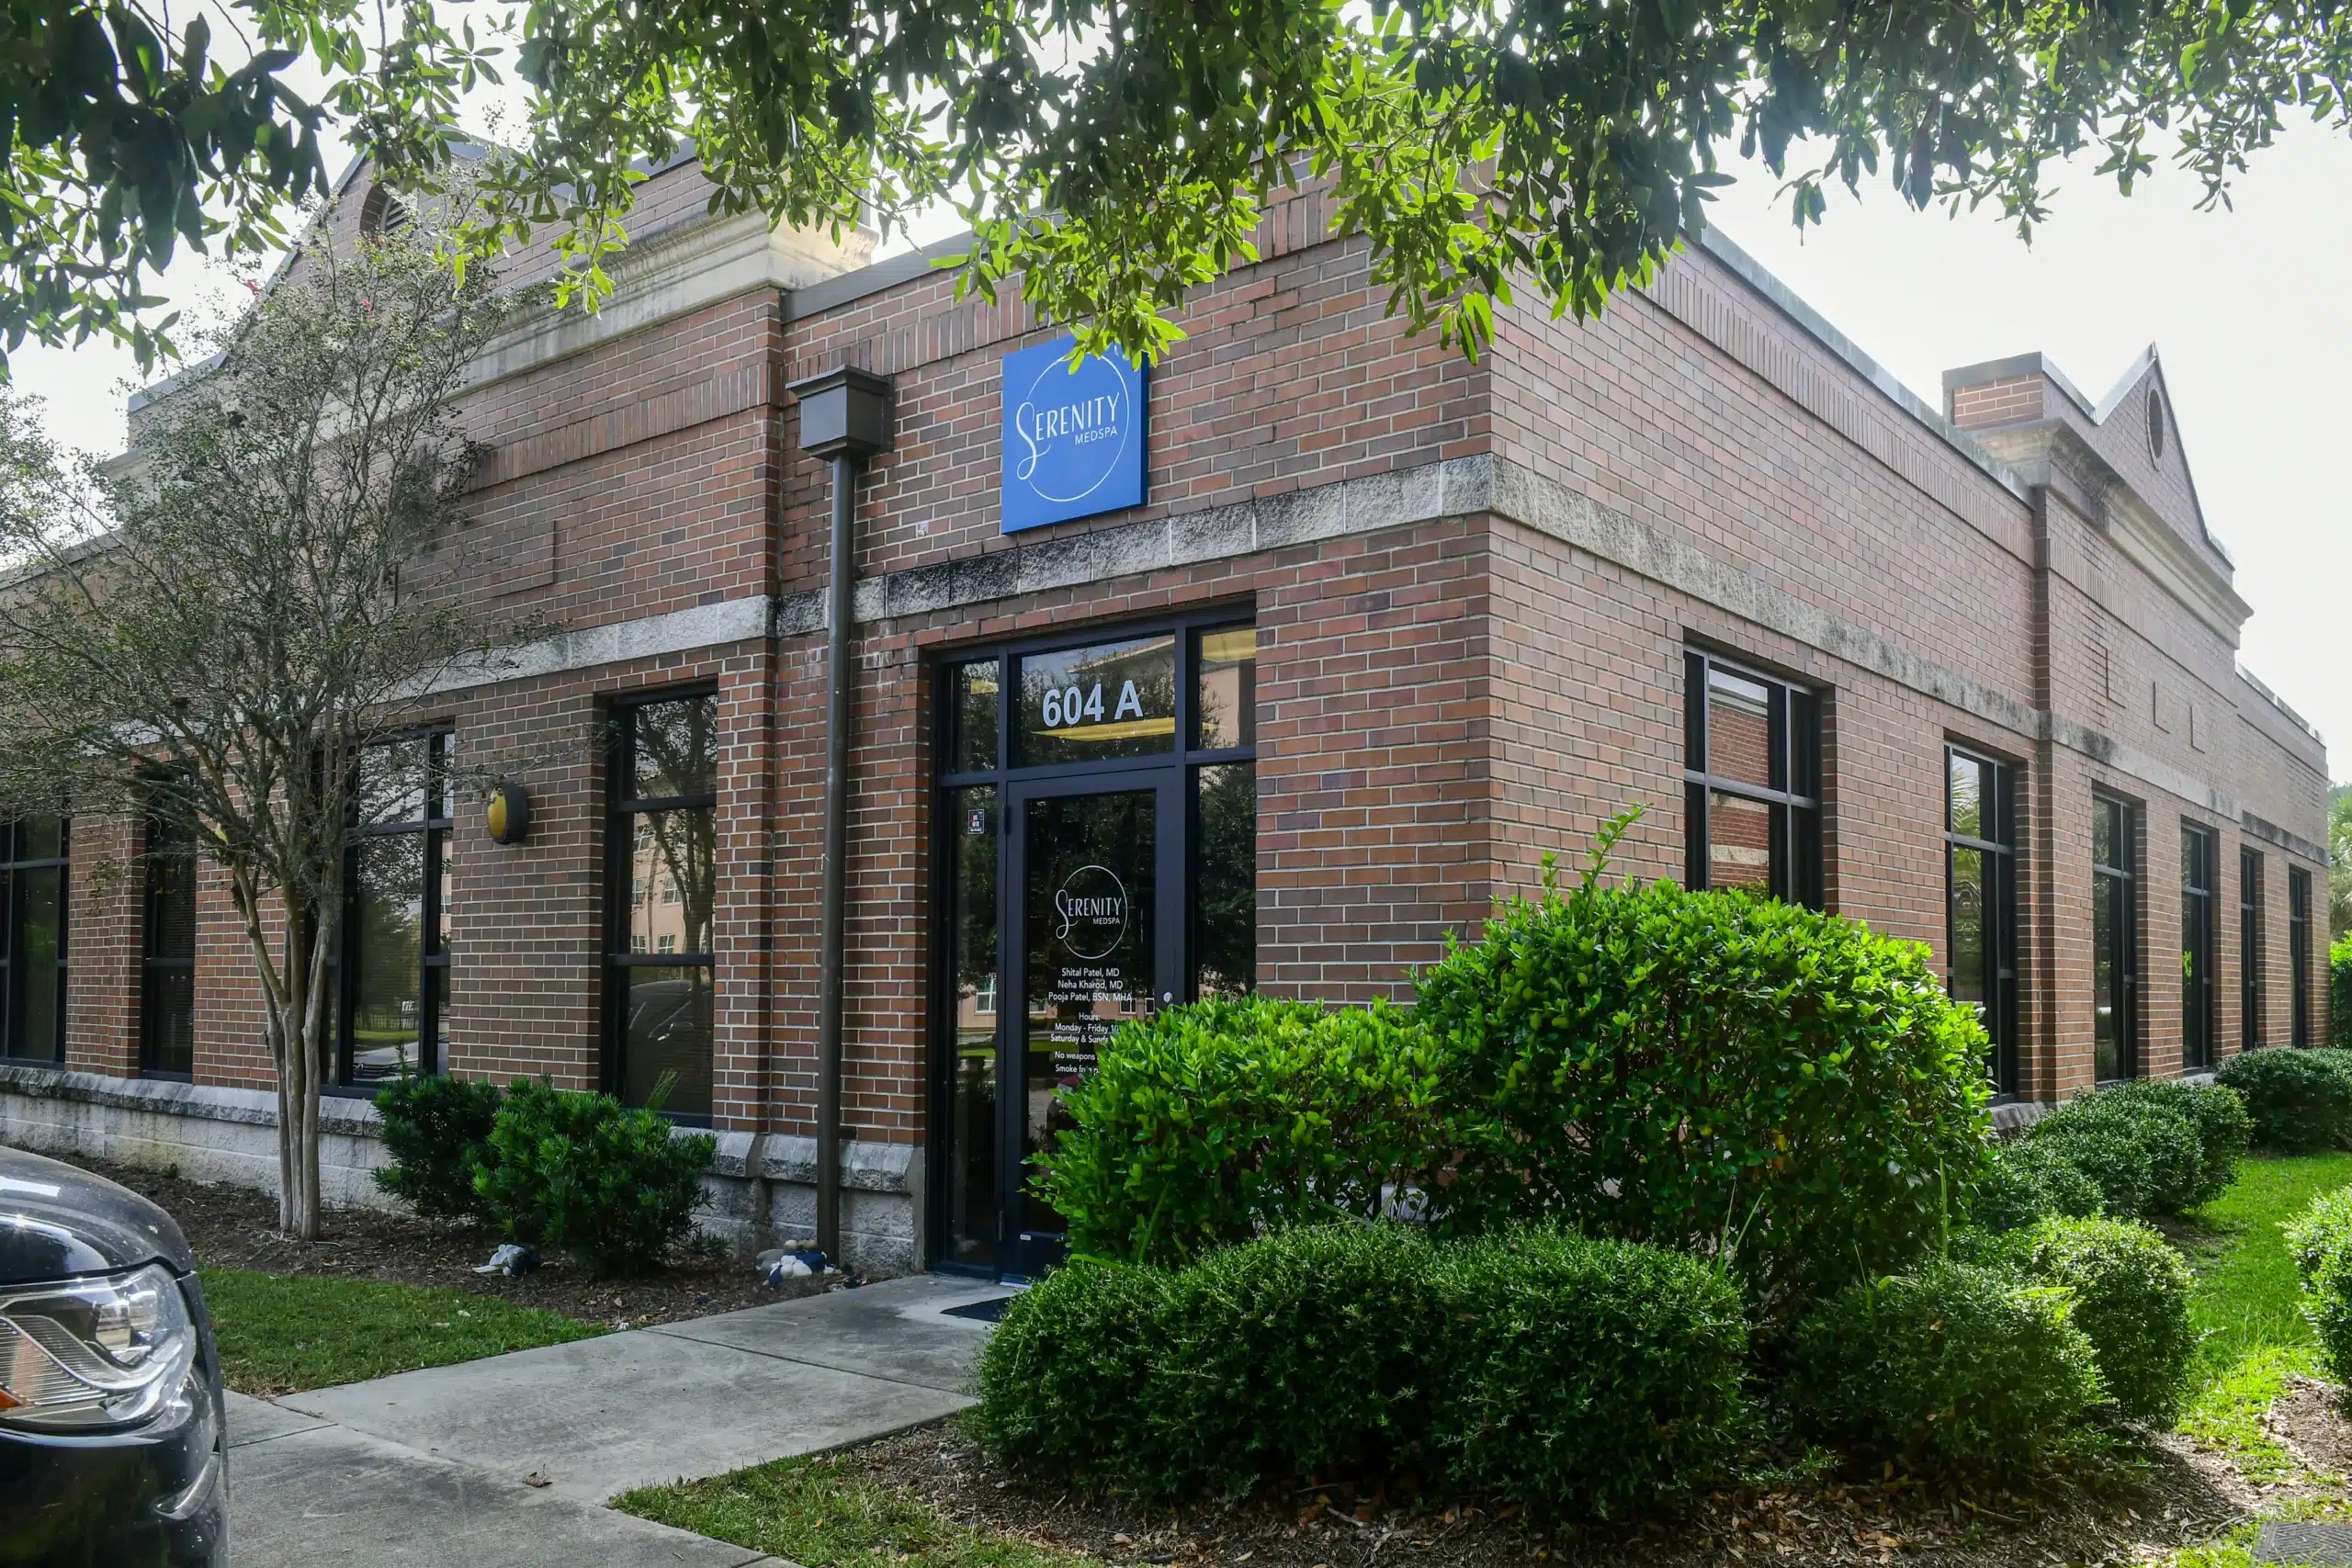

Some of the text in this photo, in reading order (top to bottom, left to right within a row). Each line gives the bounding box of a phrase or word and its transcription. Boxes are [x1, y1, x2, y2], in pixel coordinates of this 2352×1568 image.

[1016, 392, 1120, 479] SERENITY
[1074, 425, 1118, 446] MEDSPA
[1042, 680, 1144, 728] 604 A
[1056, 889, 1122, 939] SERENITY
[1092, 917, 1121, 925] MEDSPA
[1061, 967, 1120, 977] Shital Patel, MD
[1057, 980, 1124, 990] Neha Kharod, MD
[1048, 992, 1132, 1002] Pooja Patel, BSN, MHA
[1079, 1012, 1101, 1021] Hours:
[1055, 1022, 1081, 1033] Monday
[1087, 1023, 1109, 1034] Friday
[1050, 1033, 1109, 1044] Saturday & Sund
[1055, 1051, 1096, 1062] No weapons
[1055, 1064, 1078, 1072] Smoke
[1079, 1065, 1092, 1073] fre
